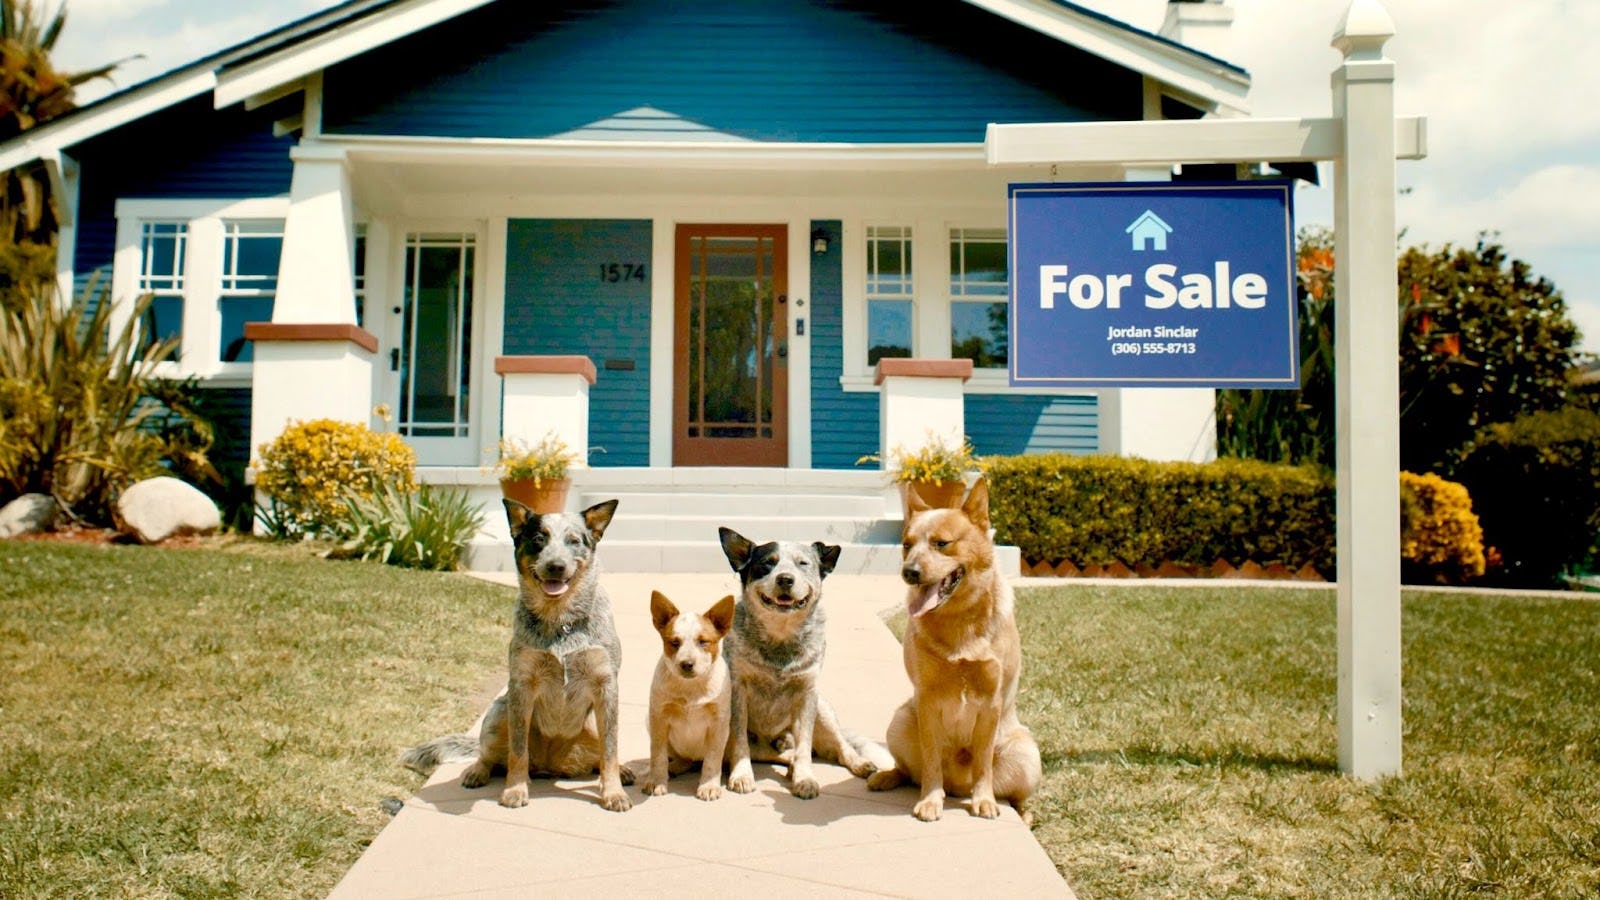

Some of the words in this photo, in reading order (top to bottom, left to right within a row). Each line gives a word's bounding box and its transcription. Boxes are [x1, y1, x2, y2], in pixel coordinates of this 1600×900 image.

[600, 263, 645, 283] 1574
[1040, 265, 1132, 309] For
[1145, 261, 1268, 309] Sale
[1107, 326, 1152, 340] Jordan
[1154, 326, 1199, 338] Sinclar
[1112, 343, 1141, 356] (306)
[1143, 343, 1196, 354] 555-8713
